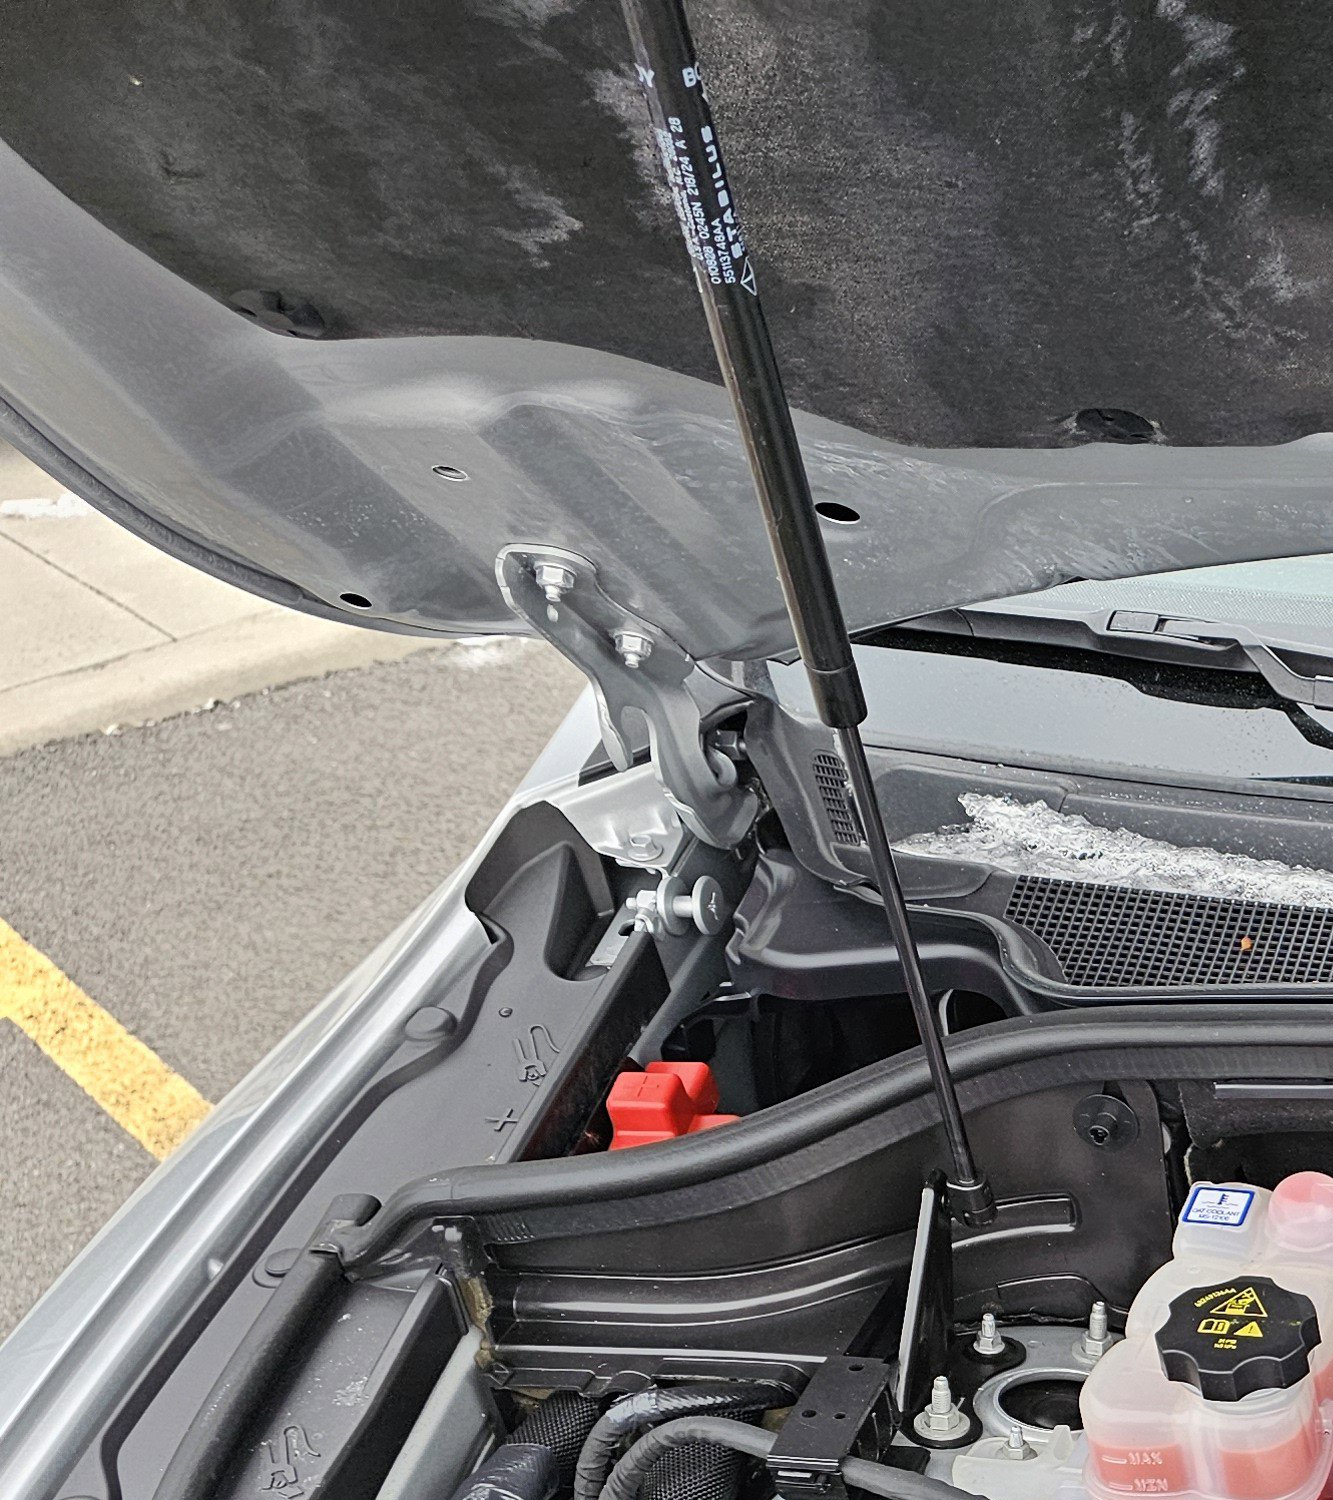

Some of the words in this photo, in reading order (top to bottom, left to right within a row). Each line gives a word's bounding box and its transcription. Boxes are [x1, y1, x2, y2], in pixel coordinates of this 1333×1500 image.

[667, 116, 684, 133] 28
[674, 139, 688, 150] A
[679, 155, 700, 197] 218/24
[701, 125, 744, 259] STABILUS
[690, 201, 710, 240] 0245N
[711, 217, 737, 284] 55113748AA
[1206, 1208, 1240, 1216] COOLANT
[1128, 1451, 1163, 1466] MAX
[1133, 1478, 1168, 1492] MIN
